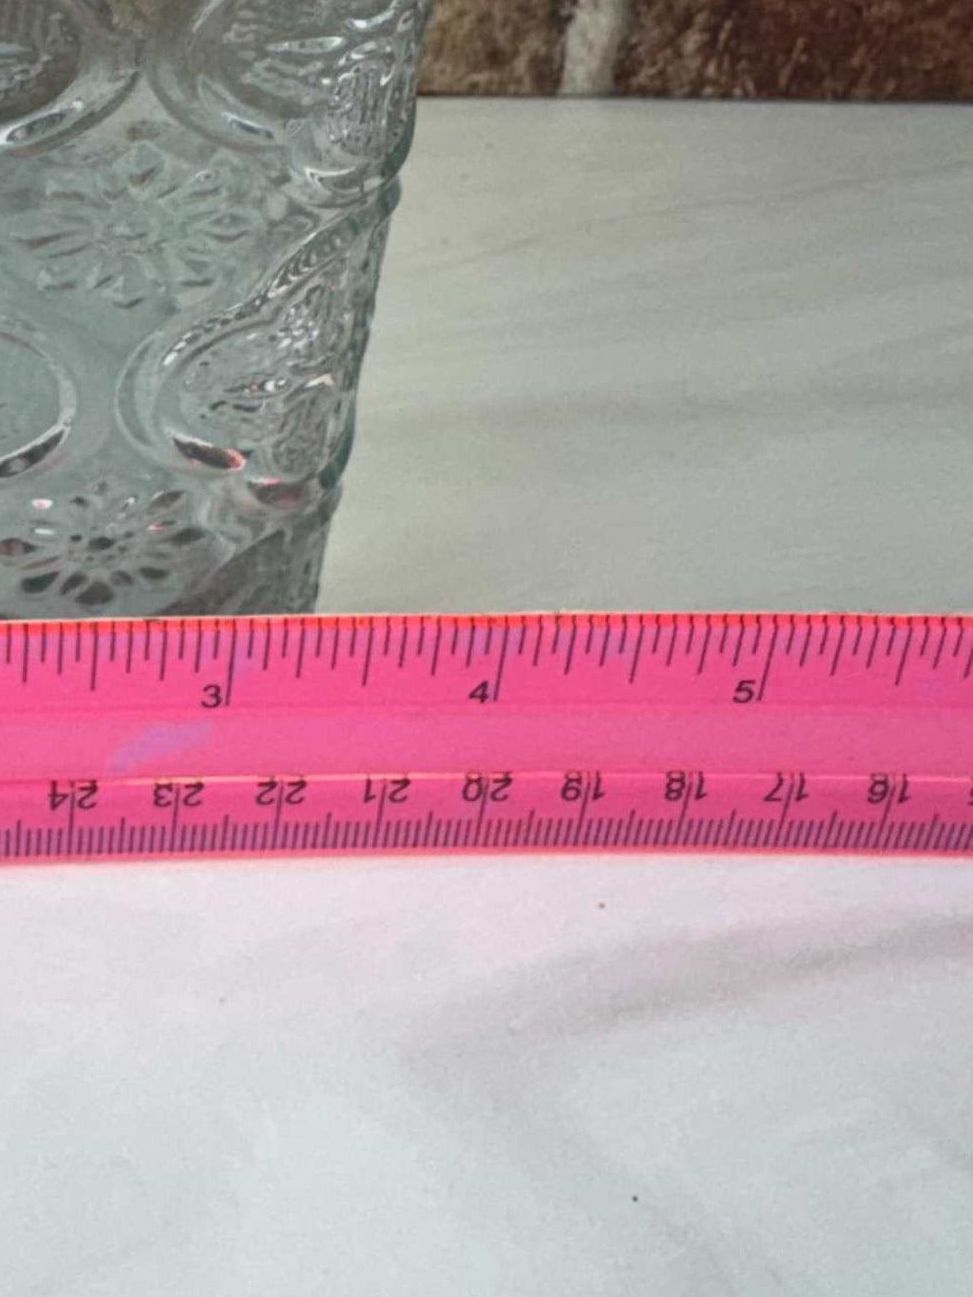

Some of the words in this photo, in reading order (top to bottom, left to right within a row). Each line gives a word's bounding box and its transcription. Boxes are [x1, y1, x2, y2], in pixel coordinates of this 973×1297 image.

[201, 684, 223, 708] 3
[468, 681, 490, 703] 4
[733, 680, 756, 703] 5
[48, 779, 98, 811] 24
[153, 782, 205, 808] 23
[255, 779, 308, 805] 22
[363, 778, 411, 803] 21
[461, 771, 513, 802] 20
[561, 771, 605, 801] 19
[665, 771, 708, 802] 18
[765, 772, 809, 802] 17
[868, 773, 910, 804] 16
